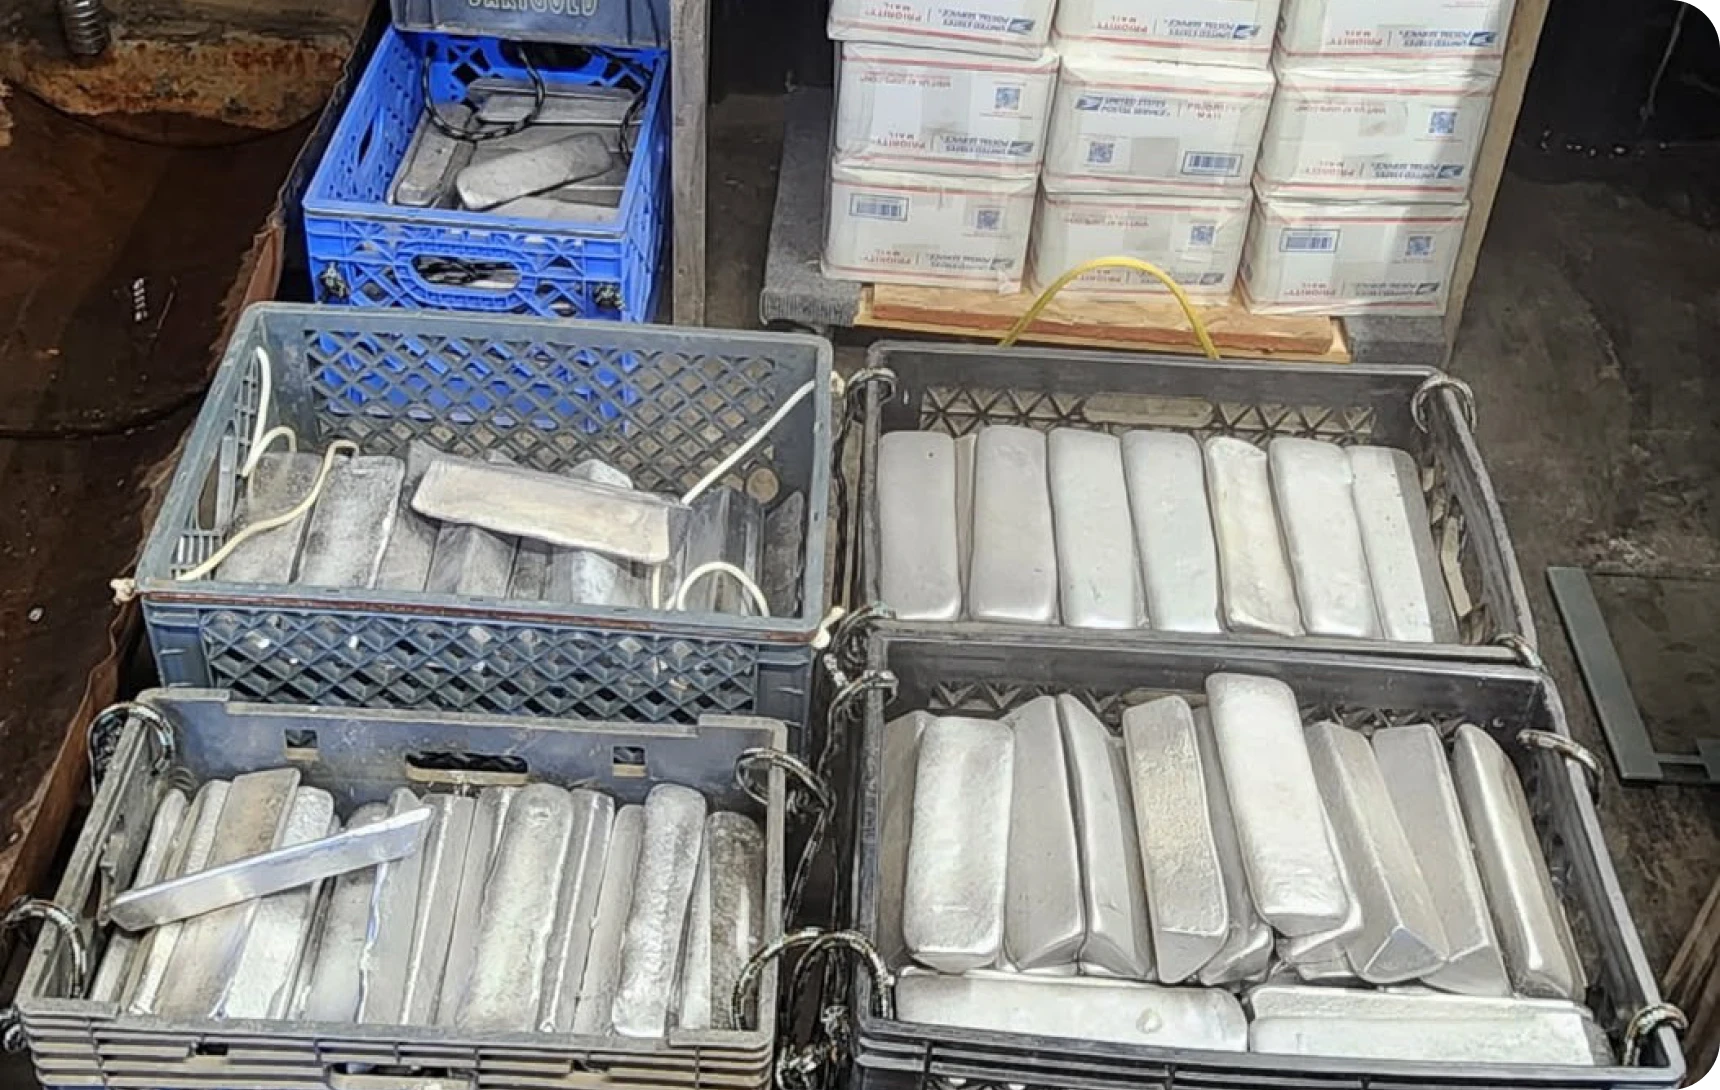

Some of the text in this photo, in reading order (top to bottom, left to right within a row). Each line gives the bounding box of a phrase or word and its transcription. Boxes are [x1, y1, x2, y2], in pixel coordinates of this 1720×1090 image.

[885, 3, 910, 11] MAIL
[866, 9, 922, 23] PRIORITY
[940, 9, 1009, 24] POSTAL SERVICE
[943, 19, 1007, 31] UNITED STATES
[1097, 23, 1147, 33] PRIORITY
[1331, 38, 1382, 46] PRIORITY
[1434, 39, 1467, 47] UNITED
[1102, 106, 1131, 115] POSTAL
[888, 132, 914, 140] MAIL
[877, 139, 925, 149] PRIORITY
[864, 256, 911, 265] PRIORITY
